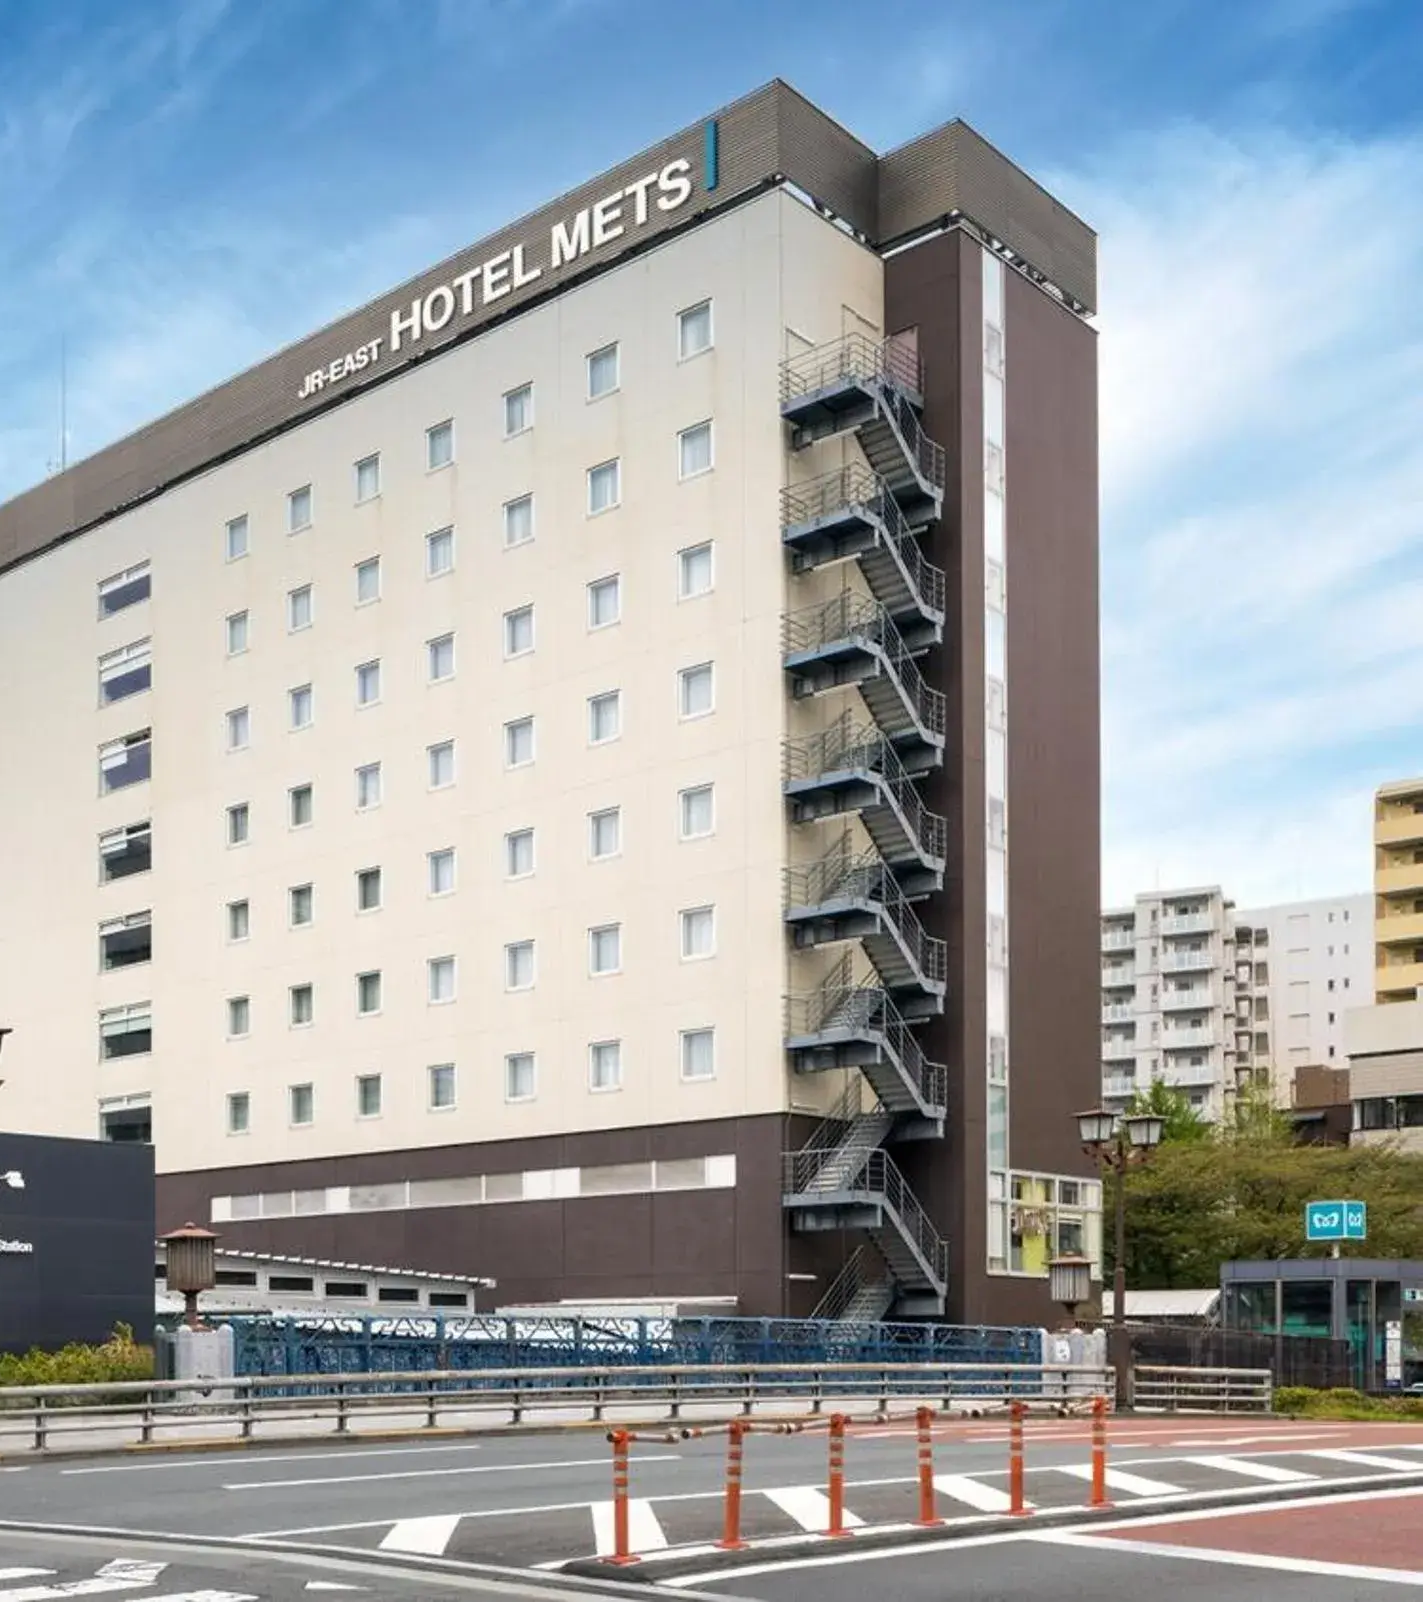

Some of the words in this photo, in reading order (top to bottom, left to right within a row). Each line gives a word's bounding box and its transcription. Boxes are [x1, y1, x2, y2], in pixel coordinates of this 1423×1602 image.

[298, 338, 383, 399] JR-EAST
[389, 243, 542, 352] HOTEL
[551, 157, 692, 270] METS
